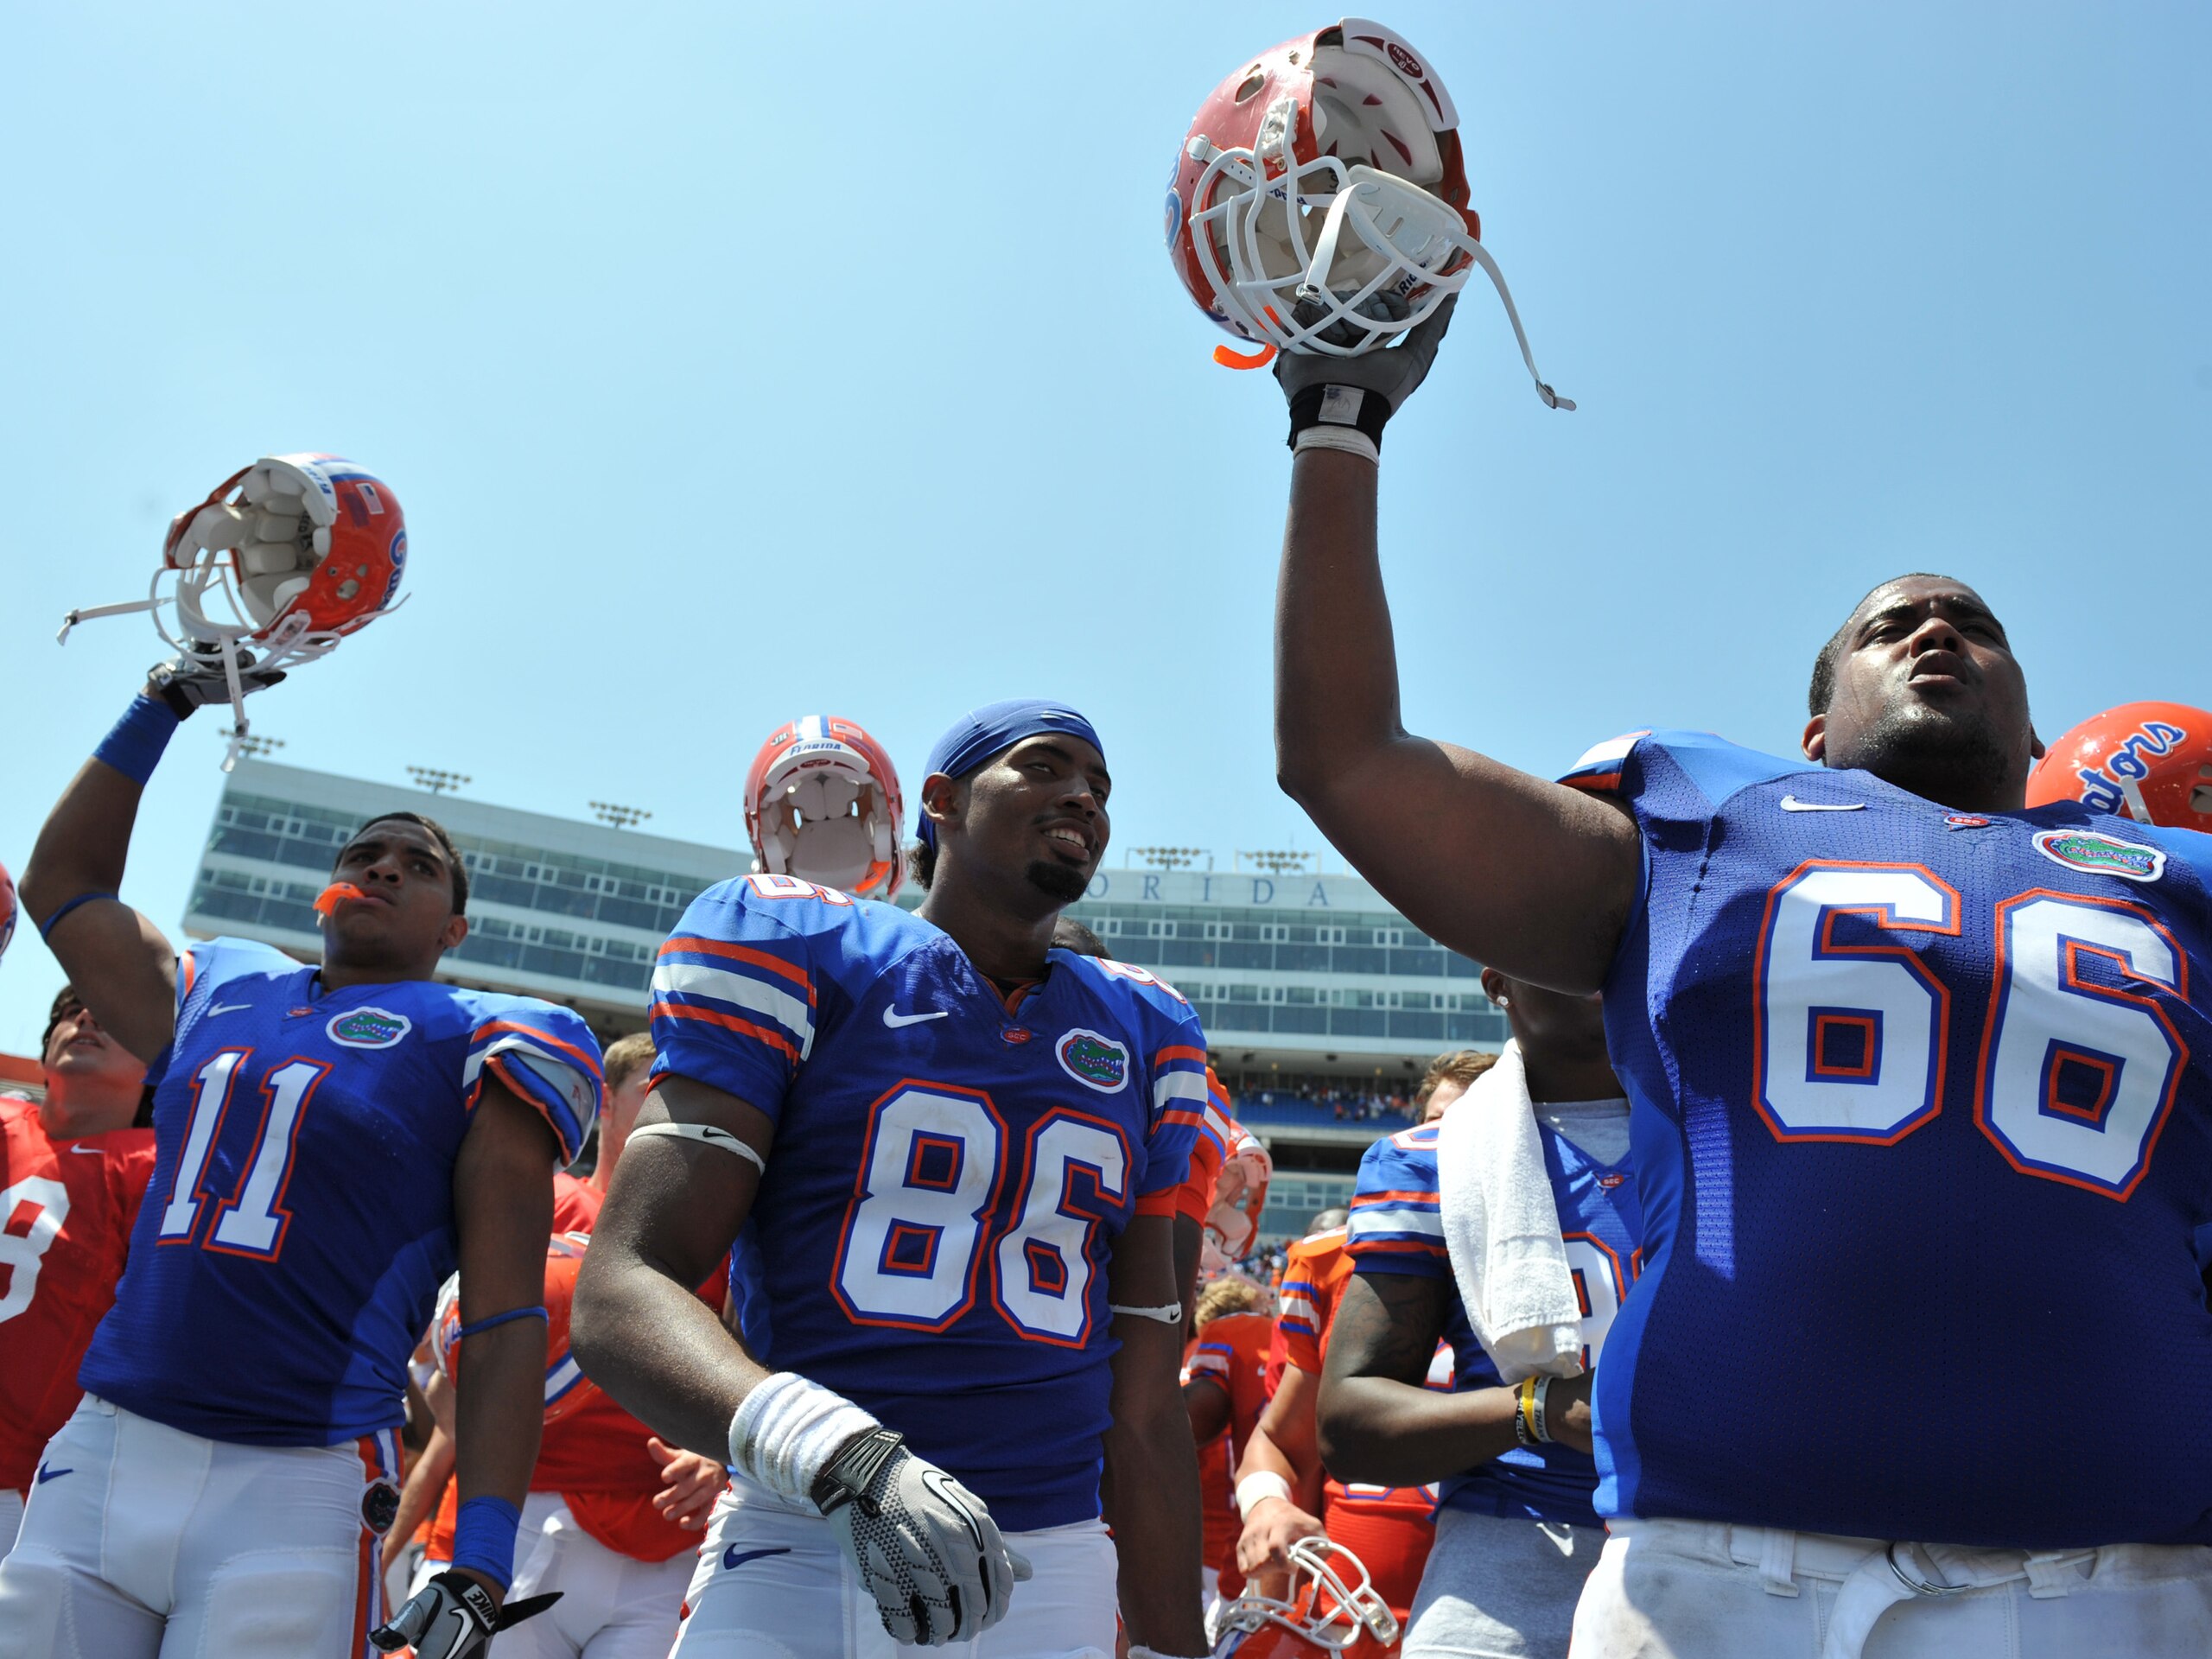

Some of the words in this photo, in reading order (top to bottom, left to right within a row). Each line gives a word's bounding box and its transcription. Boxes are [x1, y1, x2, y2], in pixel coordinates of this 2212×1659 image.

[2076, 722, 2188, 814] ators
[1084, 873, 1329, 906] ORIDA
[1751, 860, 2190, 1203] 66
[156, 1046, 334, 1262] 11
[830, 1079, 1132, 1349] 86
[467, 1591, 499, 1624] NIKE
